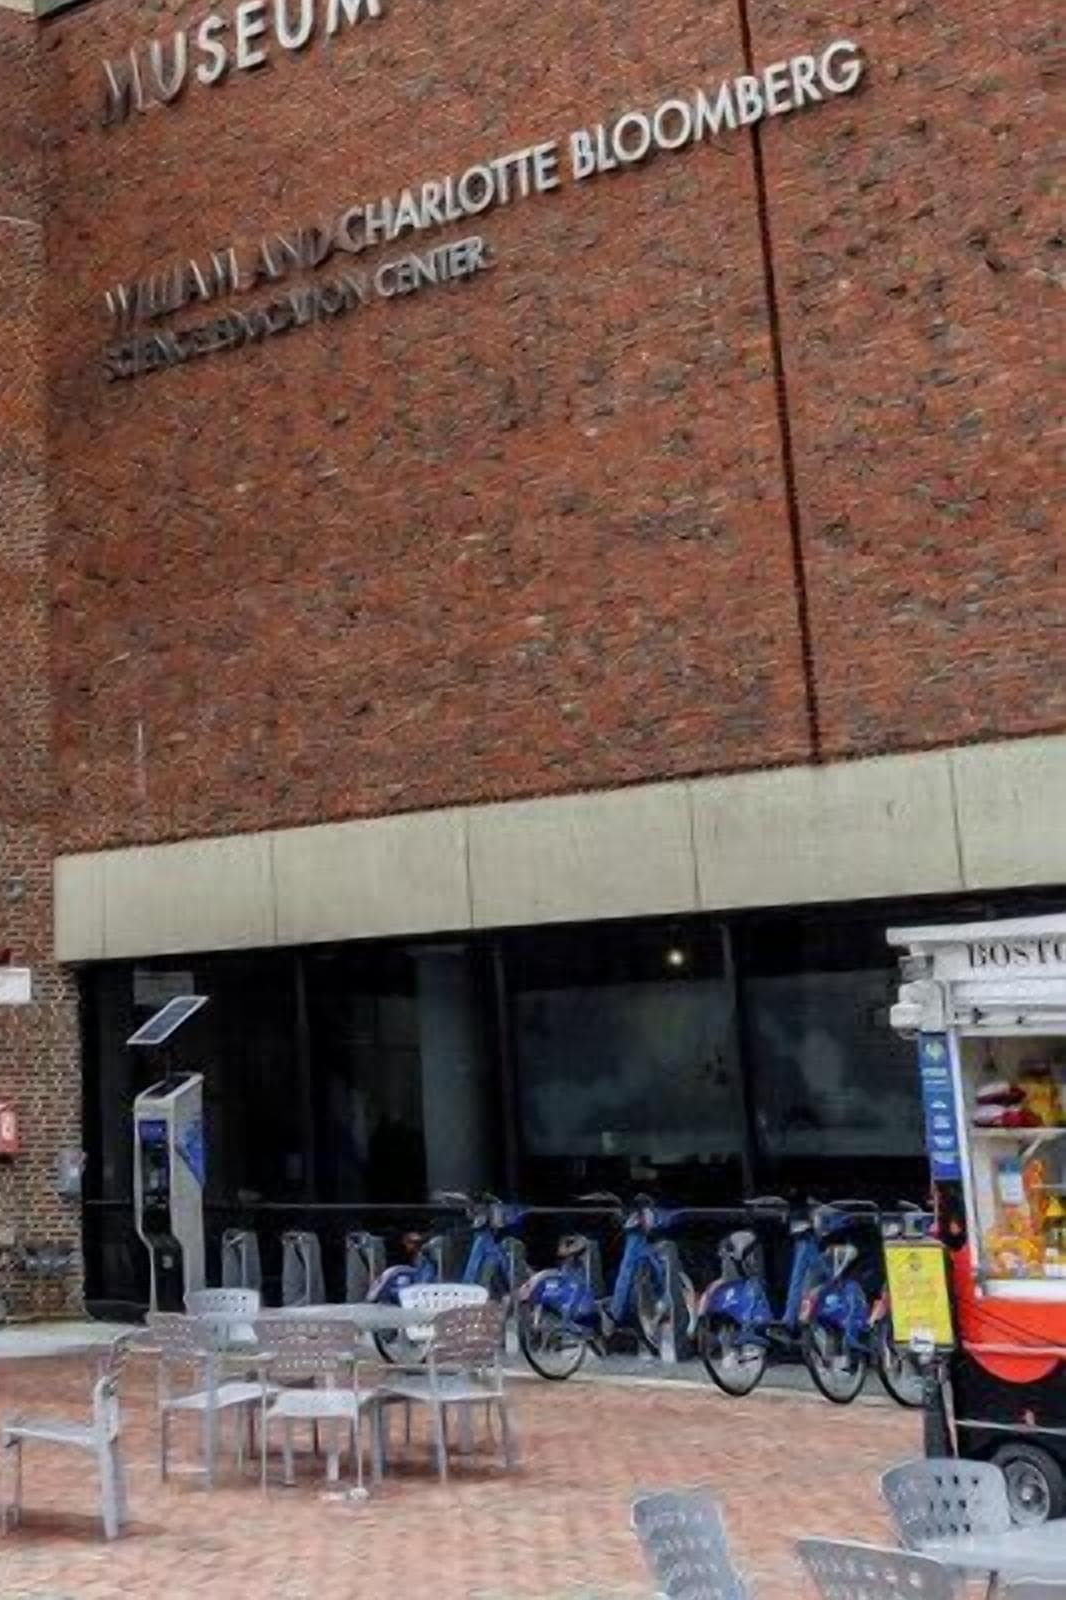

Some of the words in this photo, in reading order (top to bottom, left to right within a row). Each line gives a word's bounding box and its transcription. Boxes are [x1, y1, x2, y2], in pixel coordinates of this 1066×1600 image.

[339, 140, 562, 253] CHARLOTTE
[570, 39, 863, 180] BLOOMBERG
[373, 235, 490, 297] CENTER
